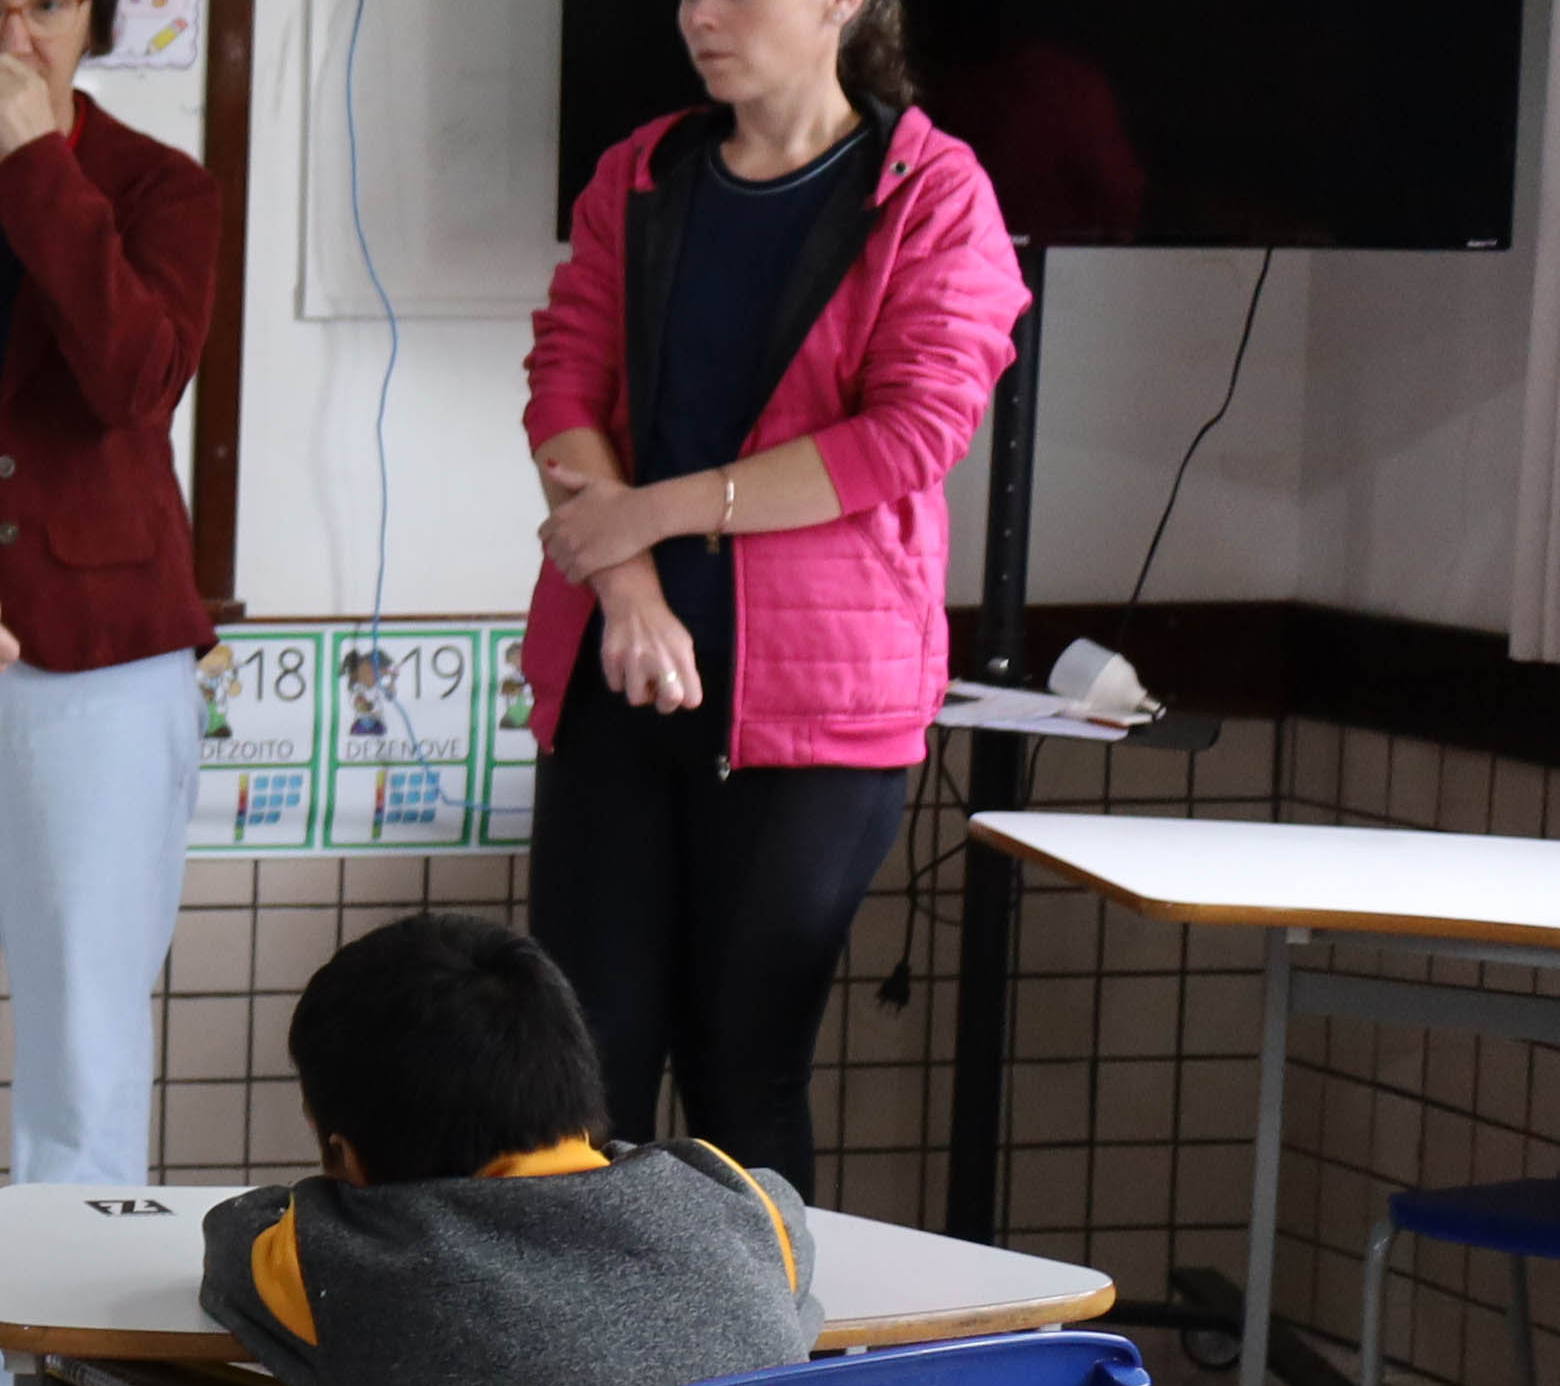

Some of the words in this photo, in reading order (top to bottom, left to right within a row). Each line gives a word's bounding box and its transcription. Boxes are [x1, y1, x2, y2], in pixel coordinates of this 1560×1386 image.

[245, 647, 306, 701] 18
[402, 645, 465, 701] 19
[201, 739, 294, 760] DEZOITO
[346, 739, 460, 759] DEZENOVE
